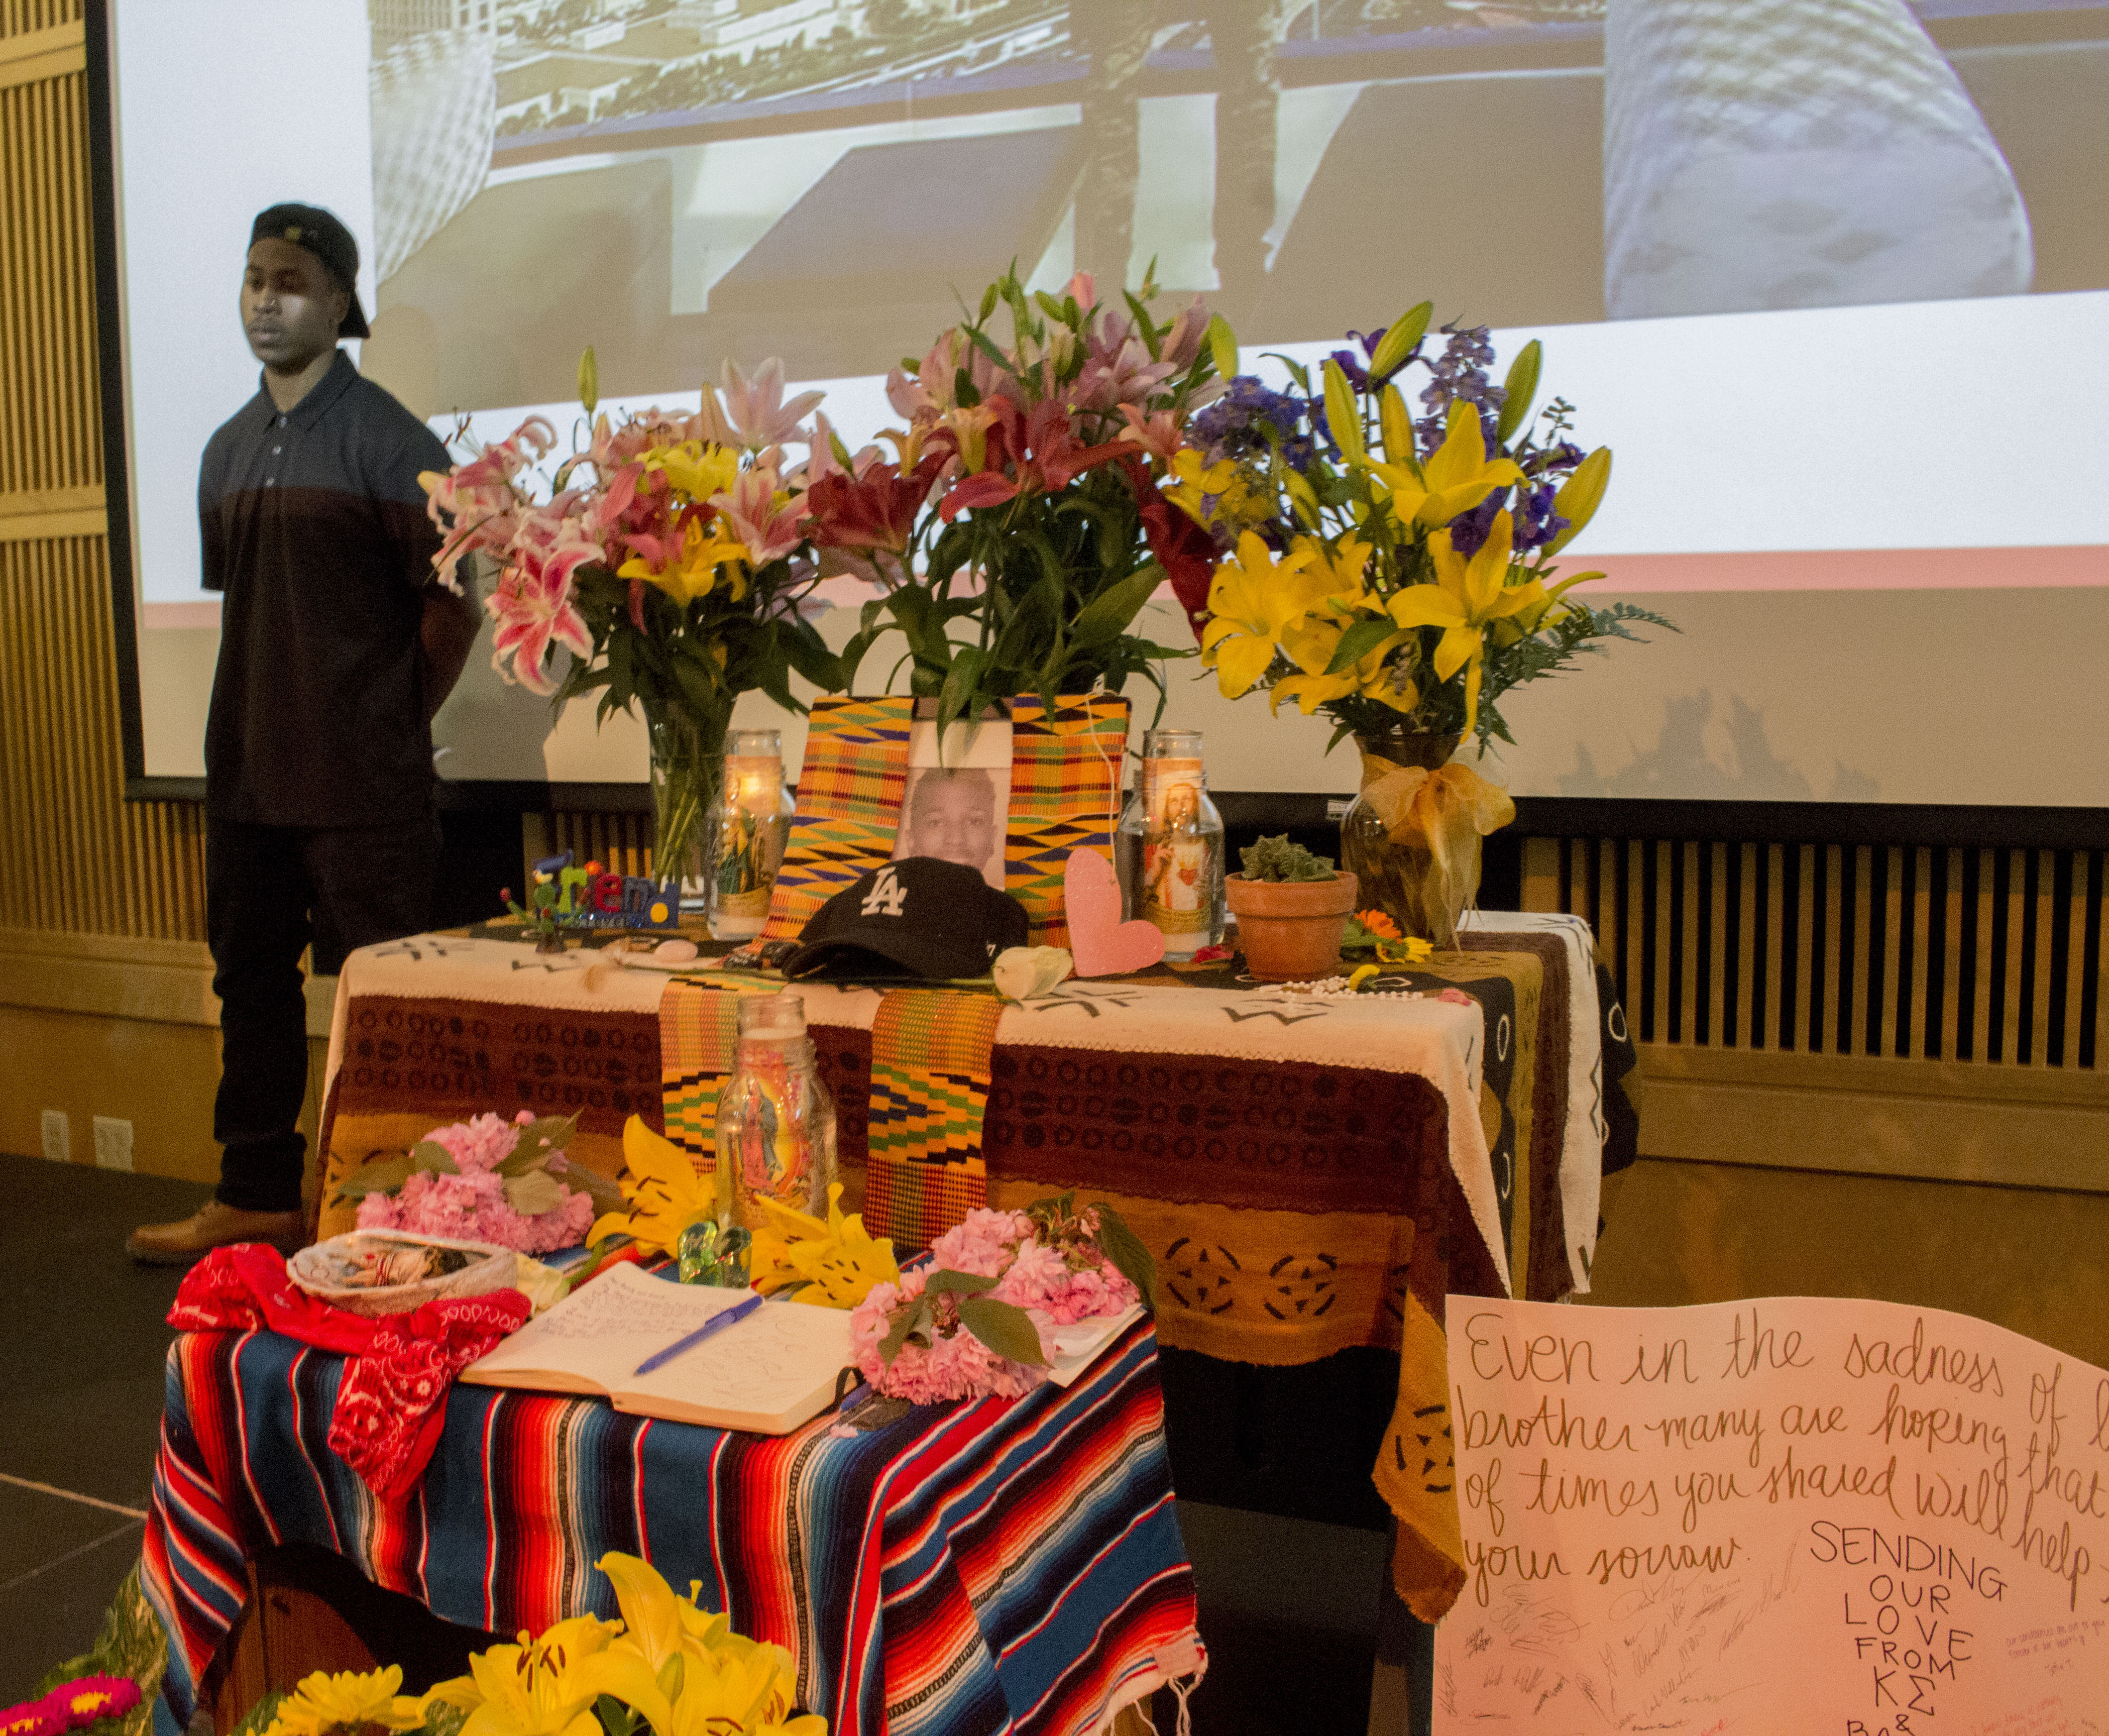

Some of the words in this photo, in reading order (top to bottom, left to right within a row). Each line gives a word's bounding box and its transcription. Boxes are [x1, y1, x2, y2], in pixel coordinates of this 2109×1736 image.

[860, 866, 908, 916] LA
[1465, 1313, 1601, 1385] Even
[1620, 1334, 1699, 1385] in
[1721, 1307, 1815, 1379] the
[1844, 1317, 2004, 1397] sadness
[2030, 1362, 2067, 1457] of
[1457, 1384, 1639, 1452] brother
[1644, 1408, 1765, 1468] many
[1780, 1405, 1848, 1435] are
[1867, 1383, 2012, 1485] hoping
[2017, 1432, 2107, 1518] that
[1465, 1457, 1504, 1537] of
[1518, 1457, 1658, 1516] times
[1675, 1471, 1751, 1534] you
[1757, 1446, 1905, 1521] shared
[2011, 1489, 2090, 1612] help
[1811, 1521, 2008, 1601] SENDING
[1464, 1539, 1572, 1607] your
[1870, 1574, 1950, 1614] OUR
[1845, 1592, 1974, 1661] LOVE
[1854, 1637, 1955, 1680] FROM
